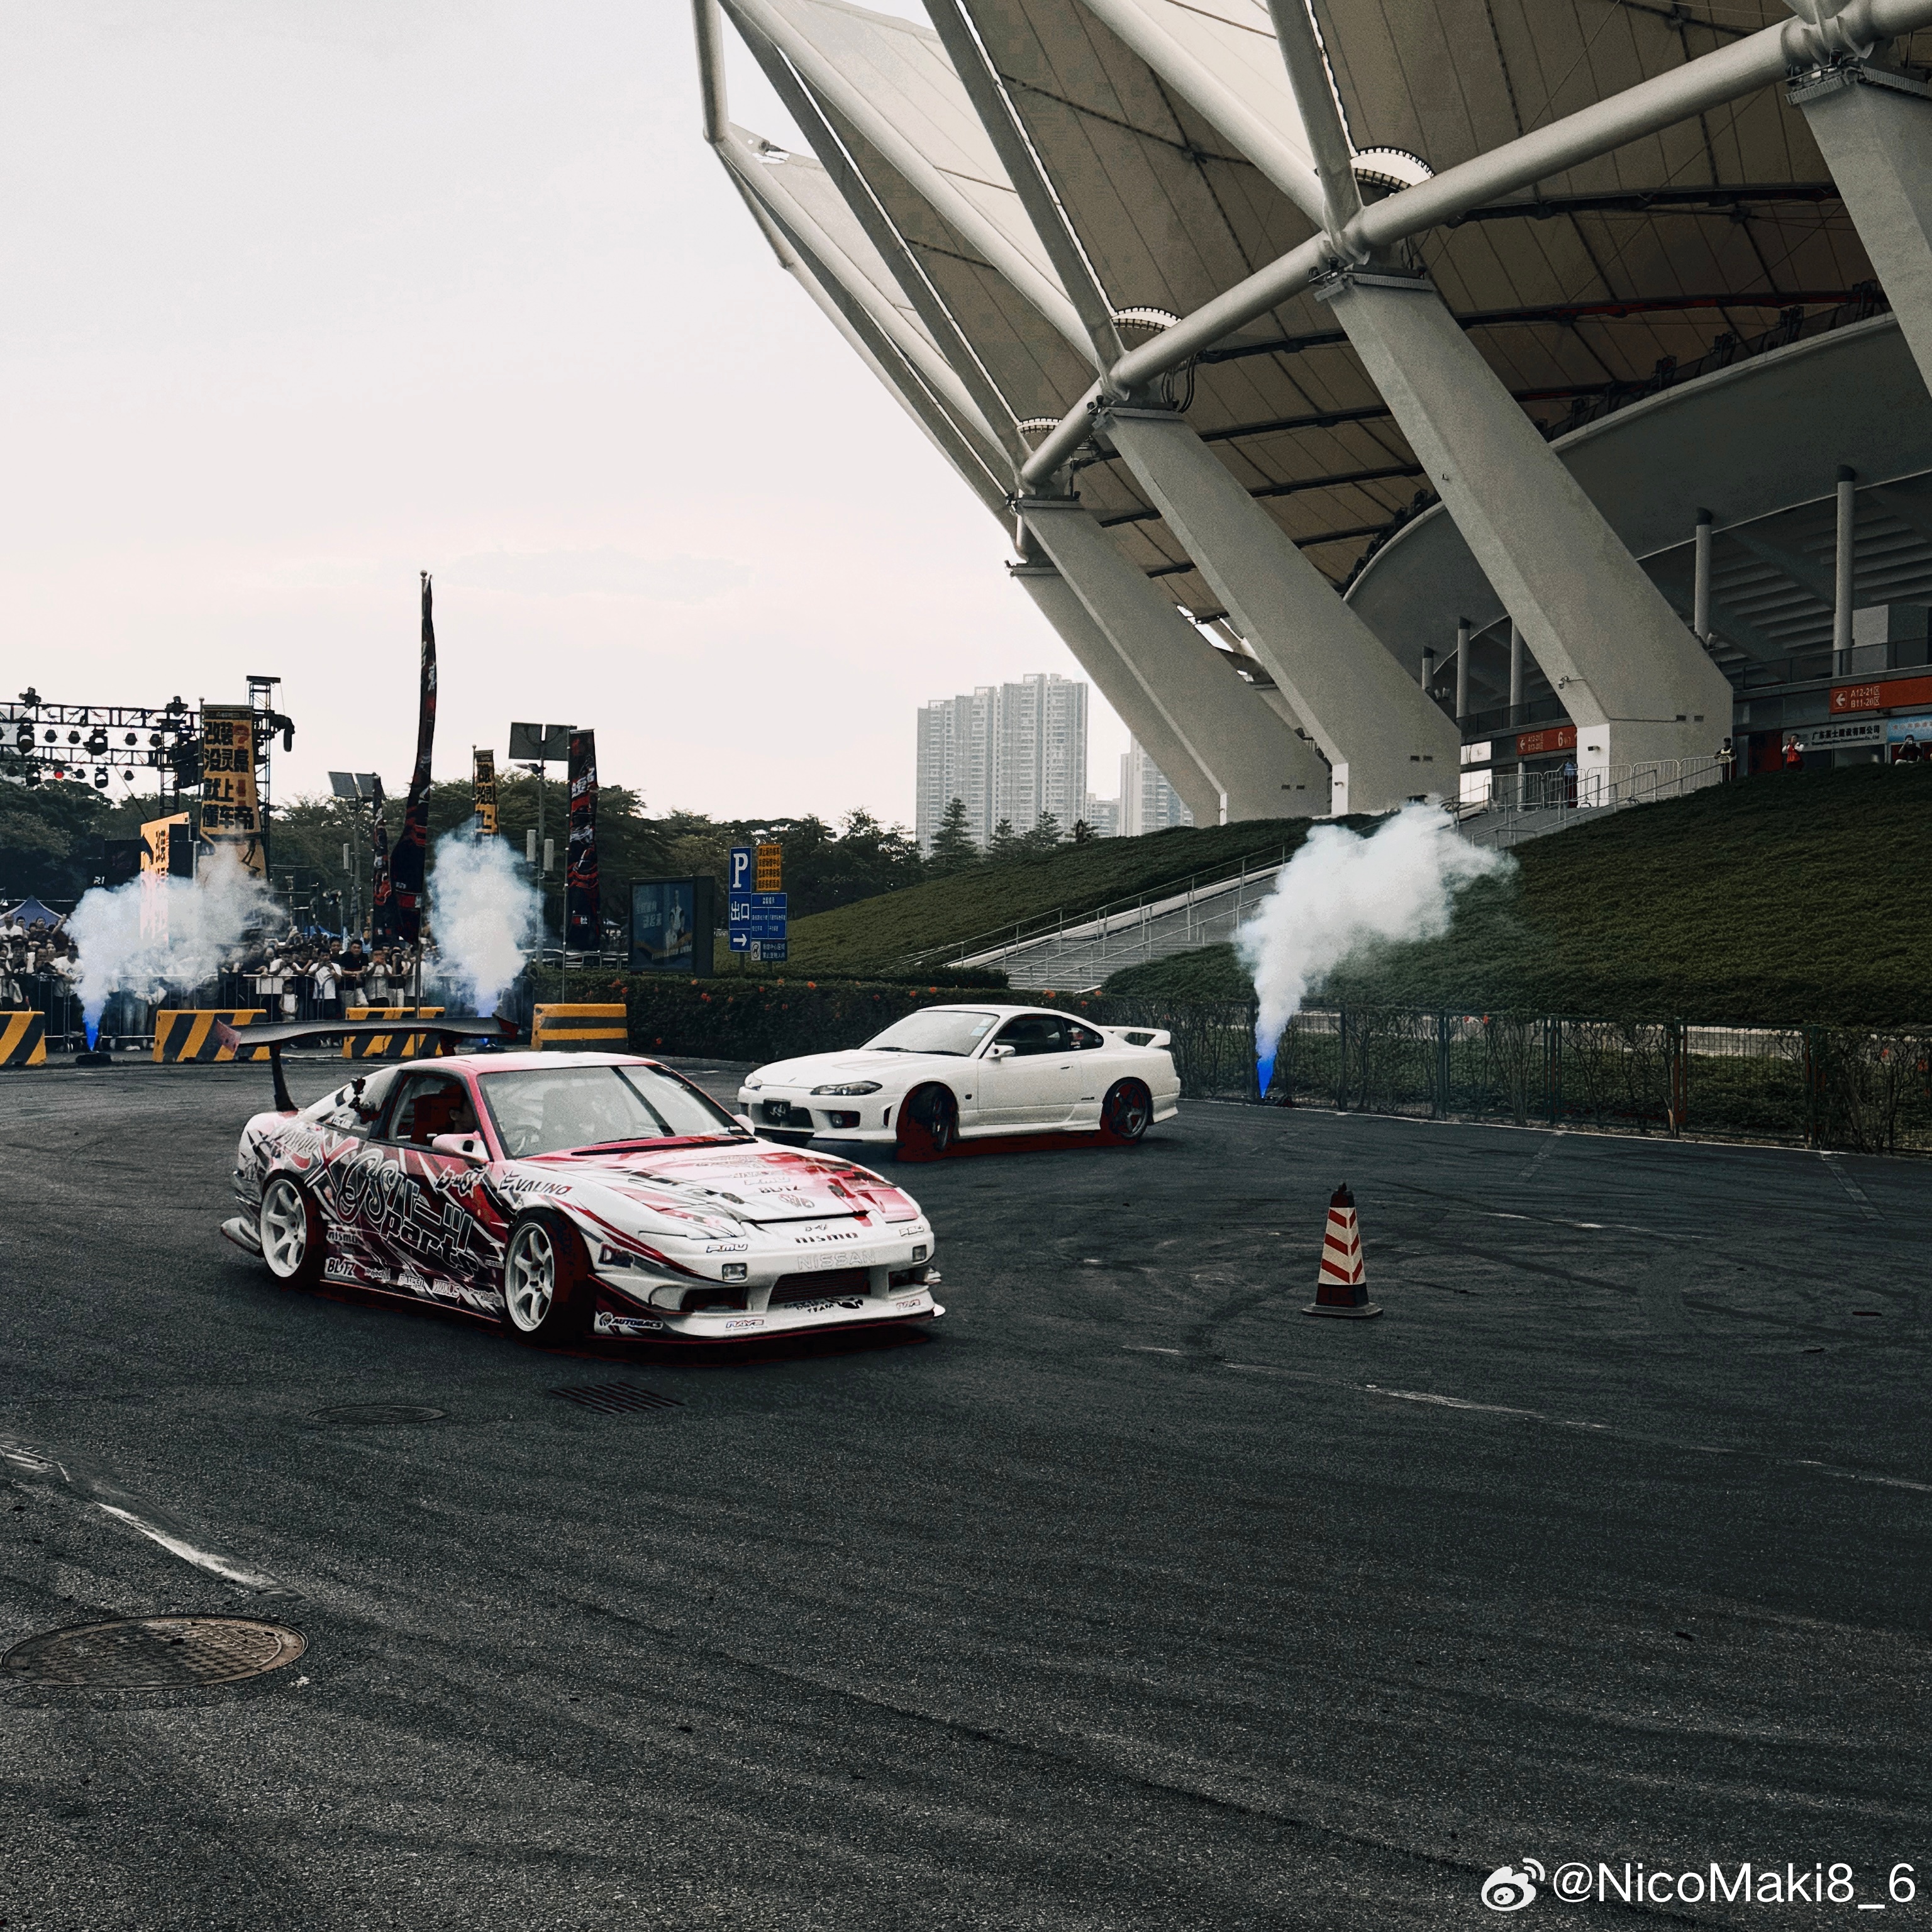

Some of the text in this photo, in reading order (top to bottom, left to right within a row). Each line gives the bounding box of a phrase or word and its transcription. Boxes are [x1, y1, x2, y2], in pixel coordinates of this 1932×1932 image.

[733, 853, 748, 888] P
[731, 901, 750, 921] 出口
[327, 1258, 356, 1276] BLITZ
[797, 1250, 876, 1270] NISSAN
[612, 1317, 662, 1328] AUTOBACS
